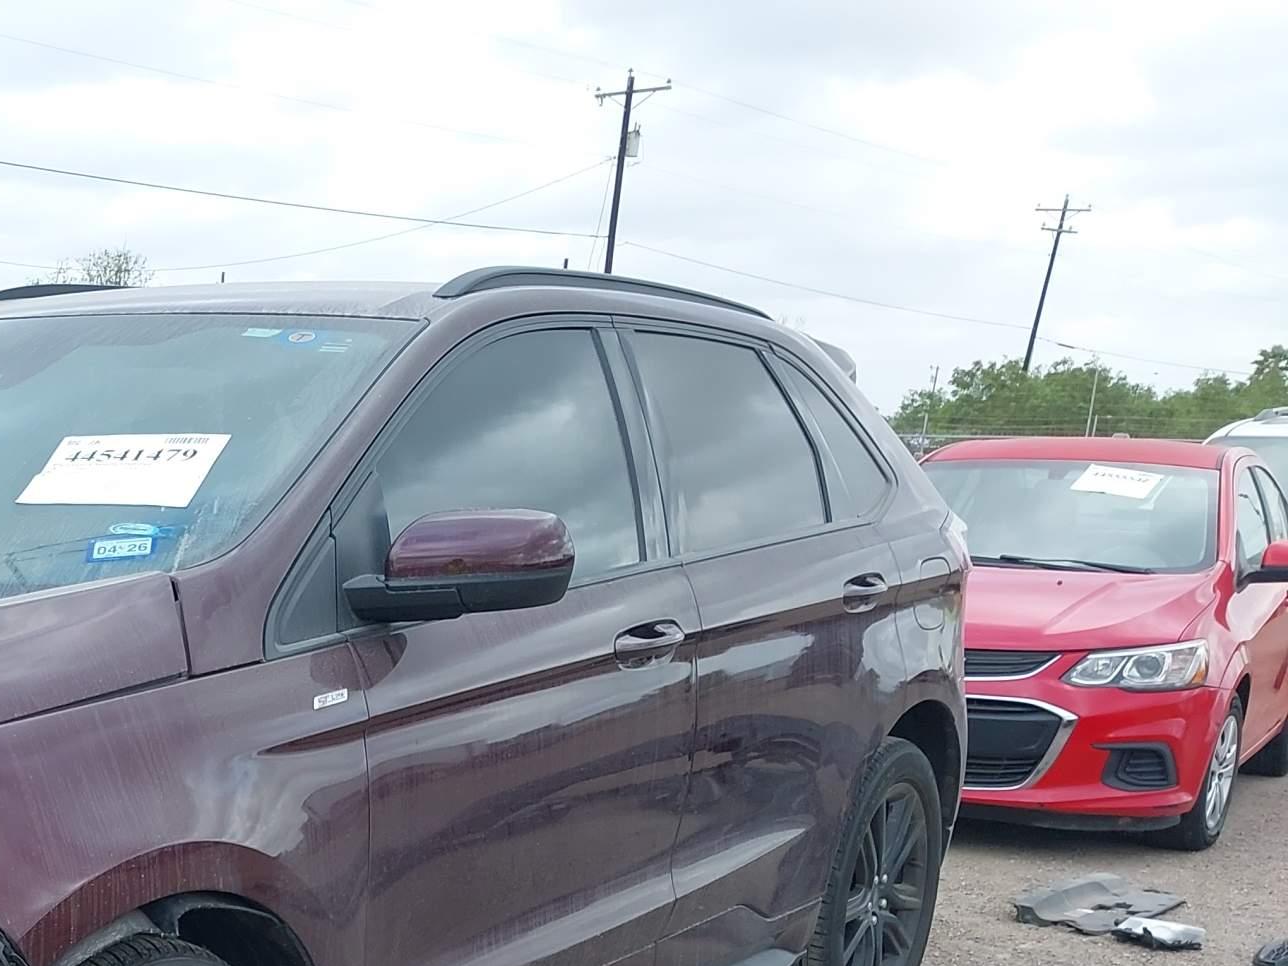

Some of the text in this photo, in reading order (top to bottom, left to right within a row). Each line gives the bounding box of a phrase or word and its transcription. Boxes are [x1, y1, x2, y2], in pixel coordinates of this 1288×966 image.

[64, 448, 198, 462] 44541479
[96, 542, 148, 556] 04 26
